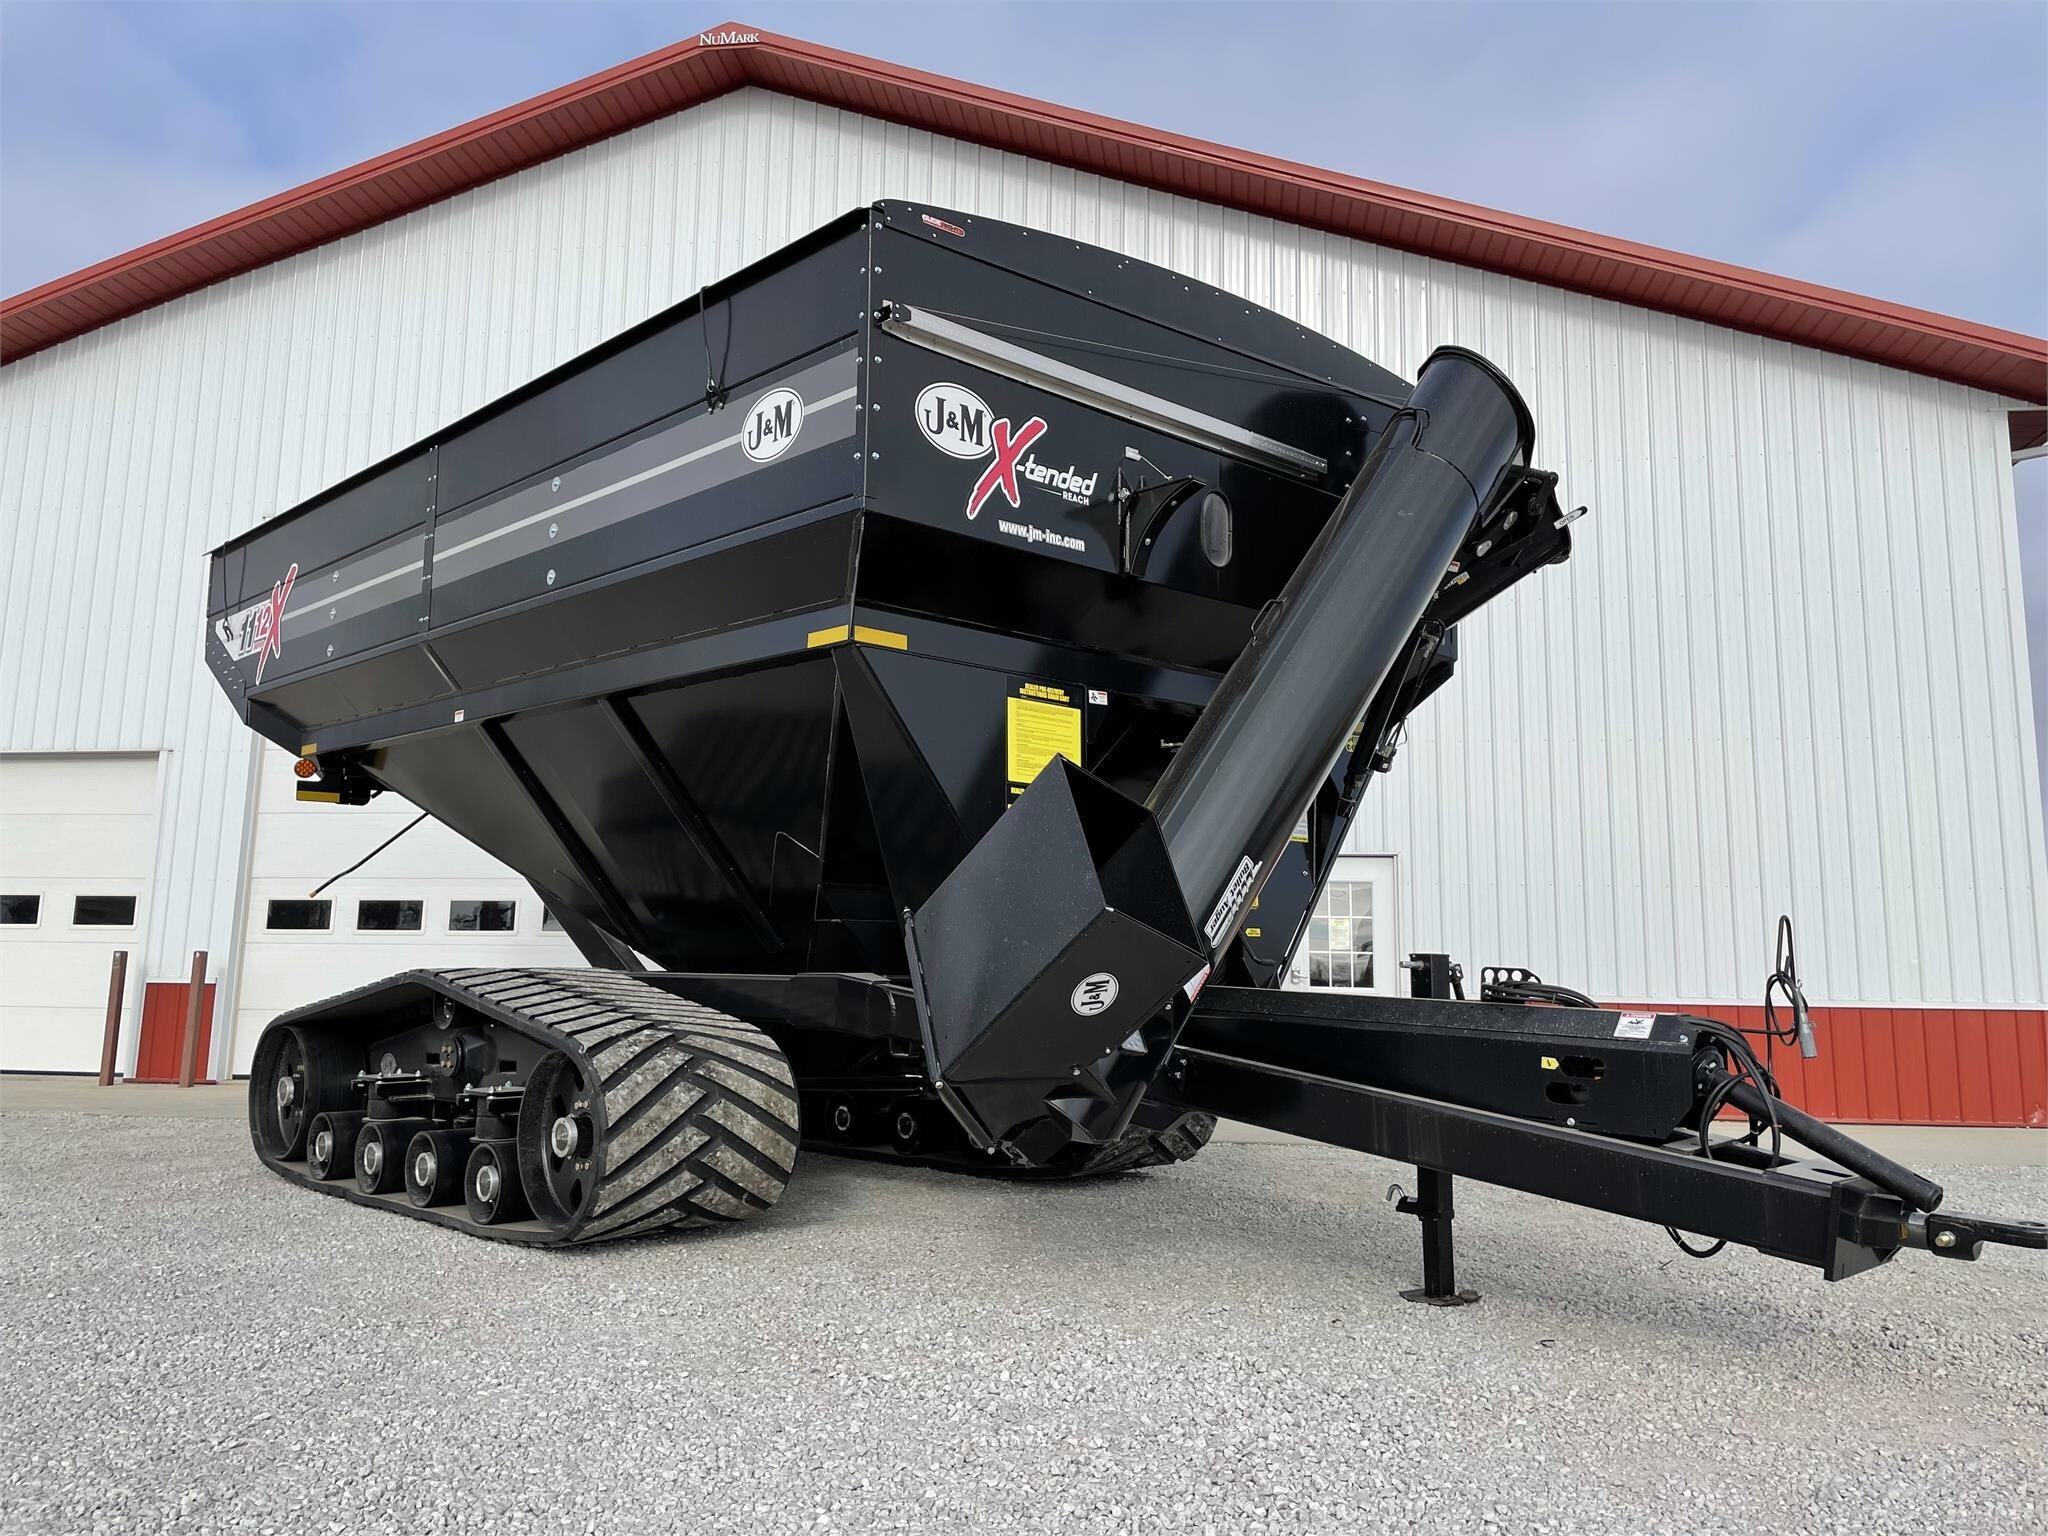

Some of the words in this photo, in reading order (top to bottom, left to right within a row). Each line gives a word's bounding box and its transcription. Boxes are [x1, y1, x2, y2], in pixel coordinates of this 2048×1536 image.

[747, 399, 794, 451] J&M
[924, 396, 985, 447] J&M
[1062, 491, 1089, 506] REACH
[998, 519, 1085, 552] www.jm-inc.com
[1080, 979, 1111, 1012] J&M
